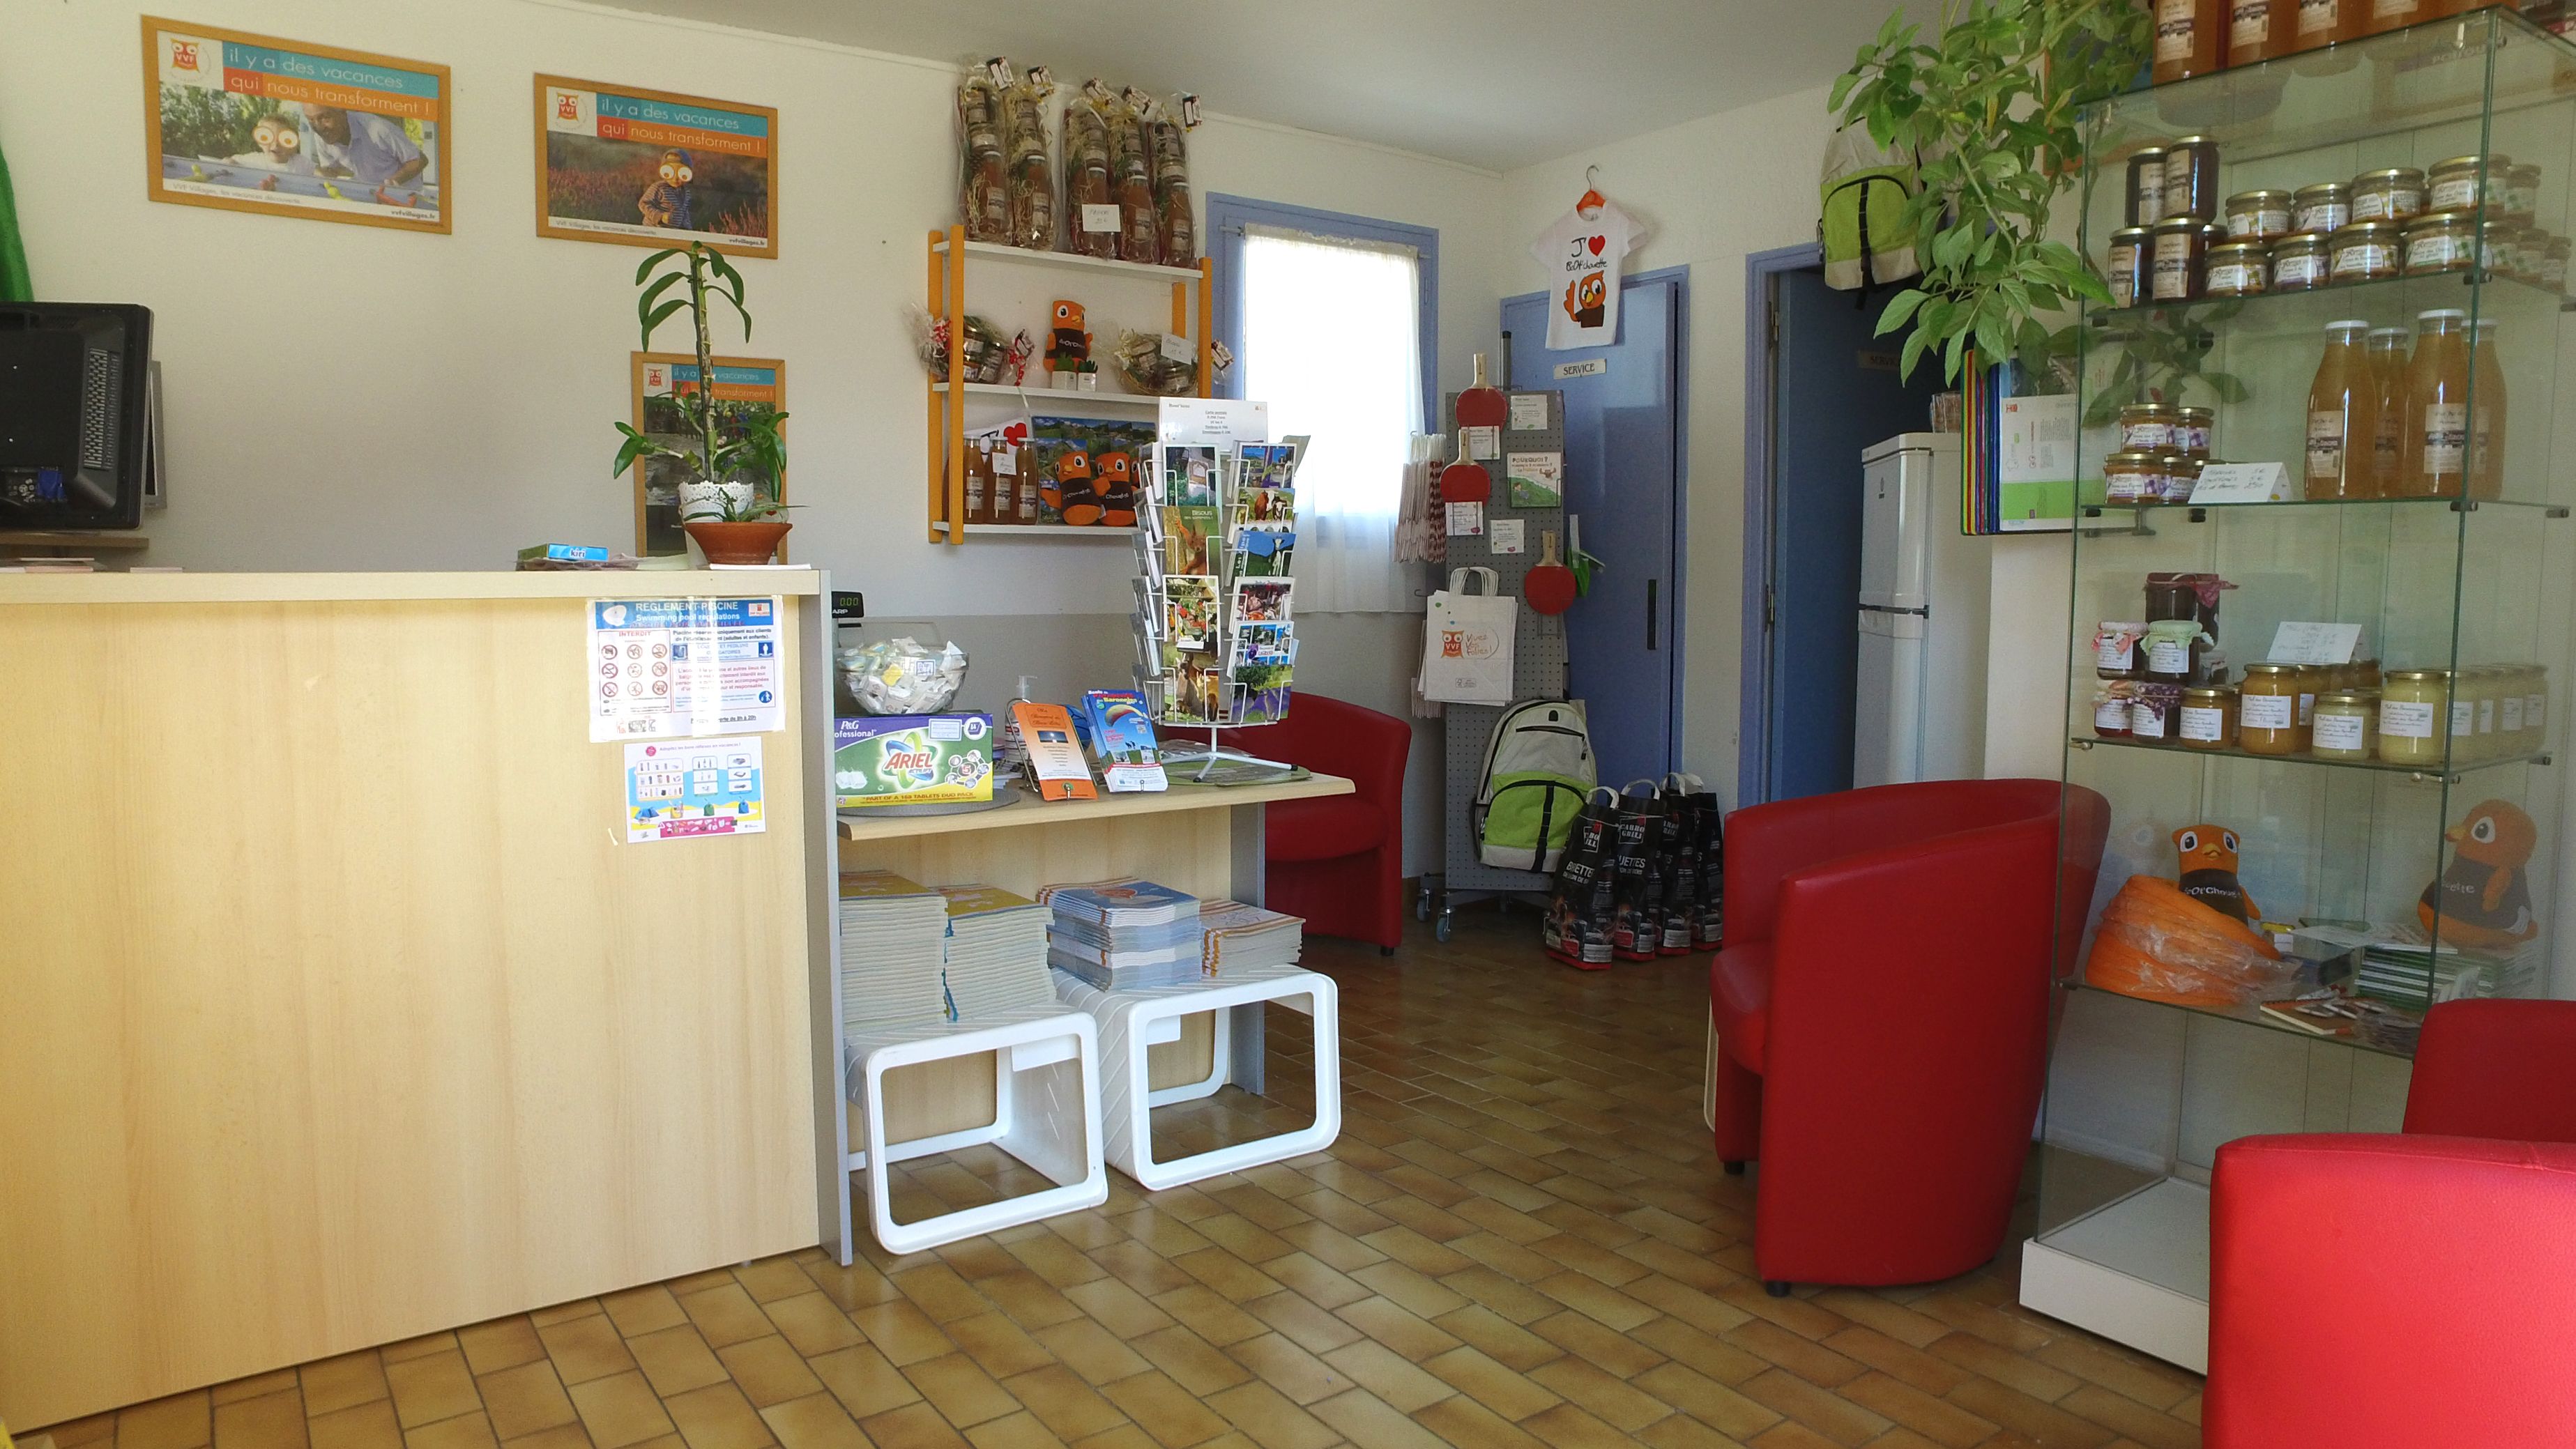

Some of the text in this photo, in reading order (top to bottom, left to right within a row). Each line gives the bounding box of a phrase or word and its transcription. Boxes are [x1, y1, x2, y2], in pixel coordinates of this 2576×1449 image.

[229, 48, 404, 89] il y a des vacances
[231, 75, 259, 93] qui
[268, 82, 308, 98] nous
[315, 89, 419, 114] transforment
[602, 98, 739, 130] il y a des vacances
[602, 122, 625, 137] qui
[631, 127, 664, 139] nous
[669, 130, 752, 151] transforment
[674, 367, 680, 376] il
[682, 370, 688, 379] y
[718, 372, 760, 381] vacances
[1564, 362, 1595, 376] SERVICE
[715, 387, 767, 398] transforment
[570, 548, 586, 558] kiri
[637, 613, 677, 623] Swimming
[698, 613, 740, 622] regulations
[841, 720, 860, 730] P&G
[834, 729, 874, 738] ofessional
[884, 752, 933, 769] ARIEL
